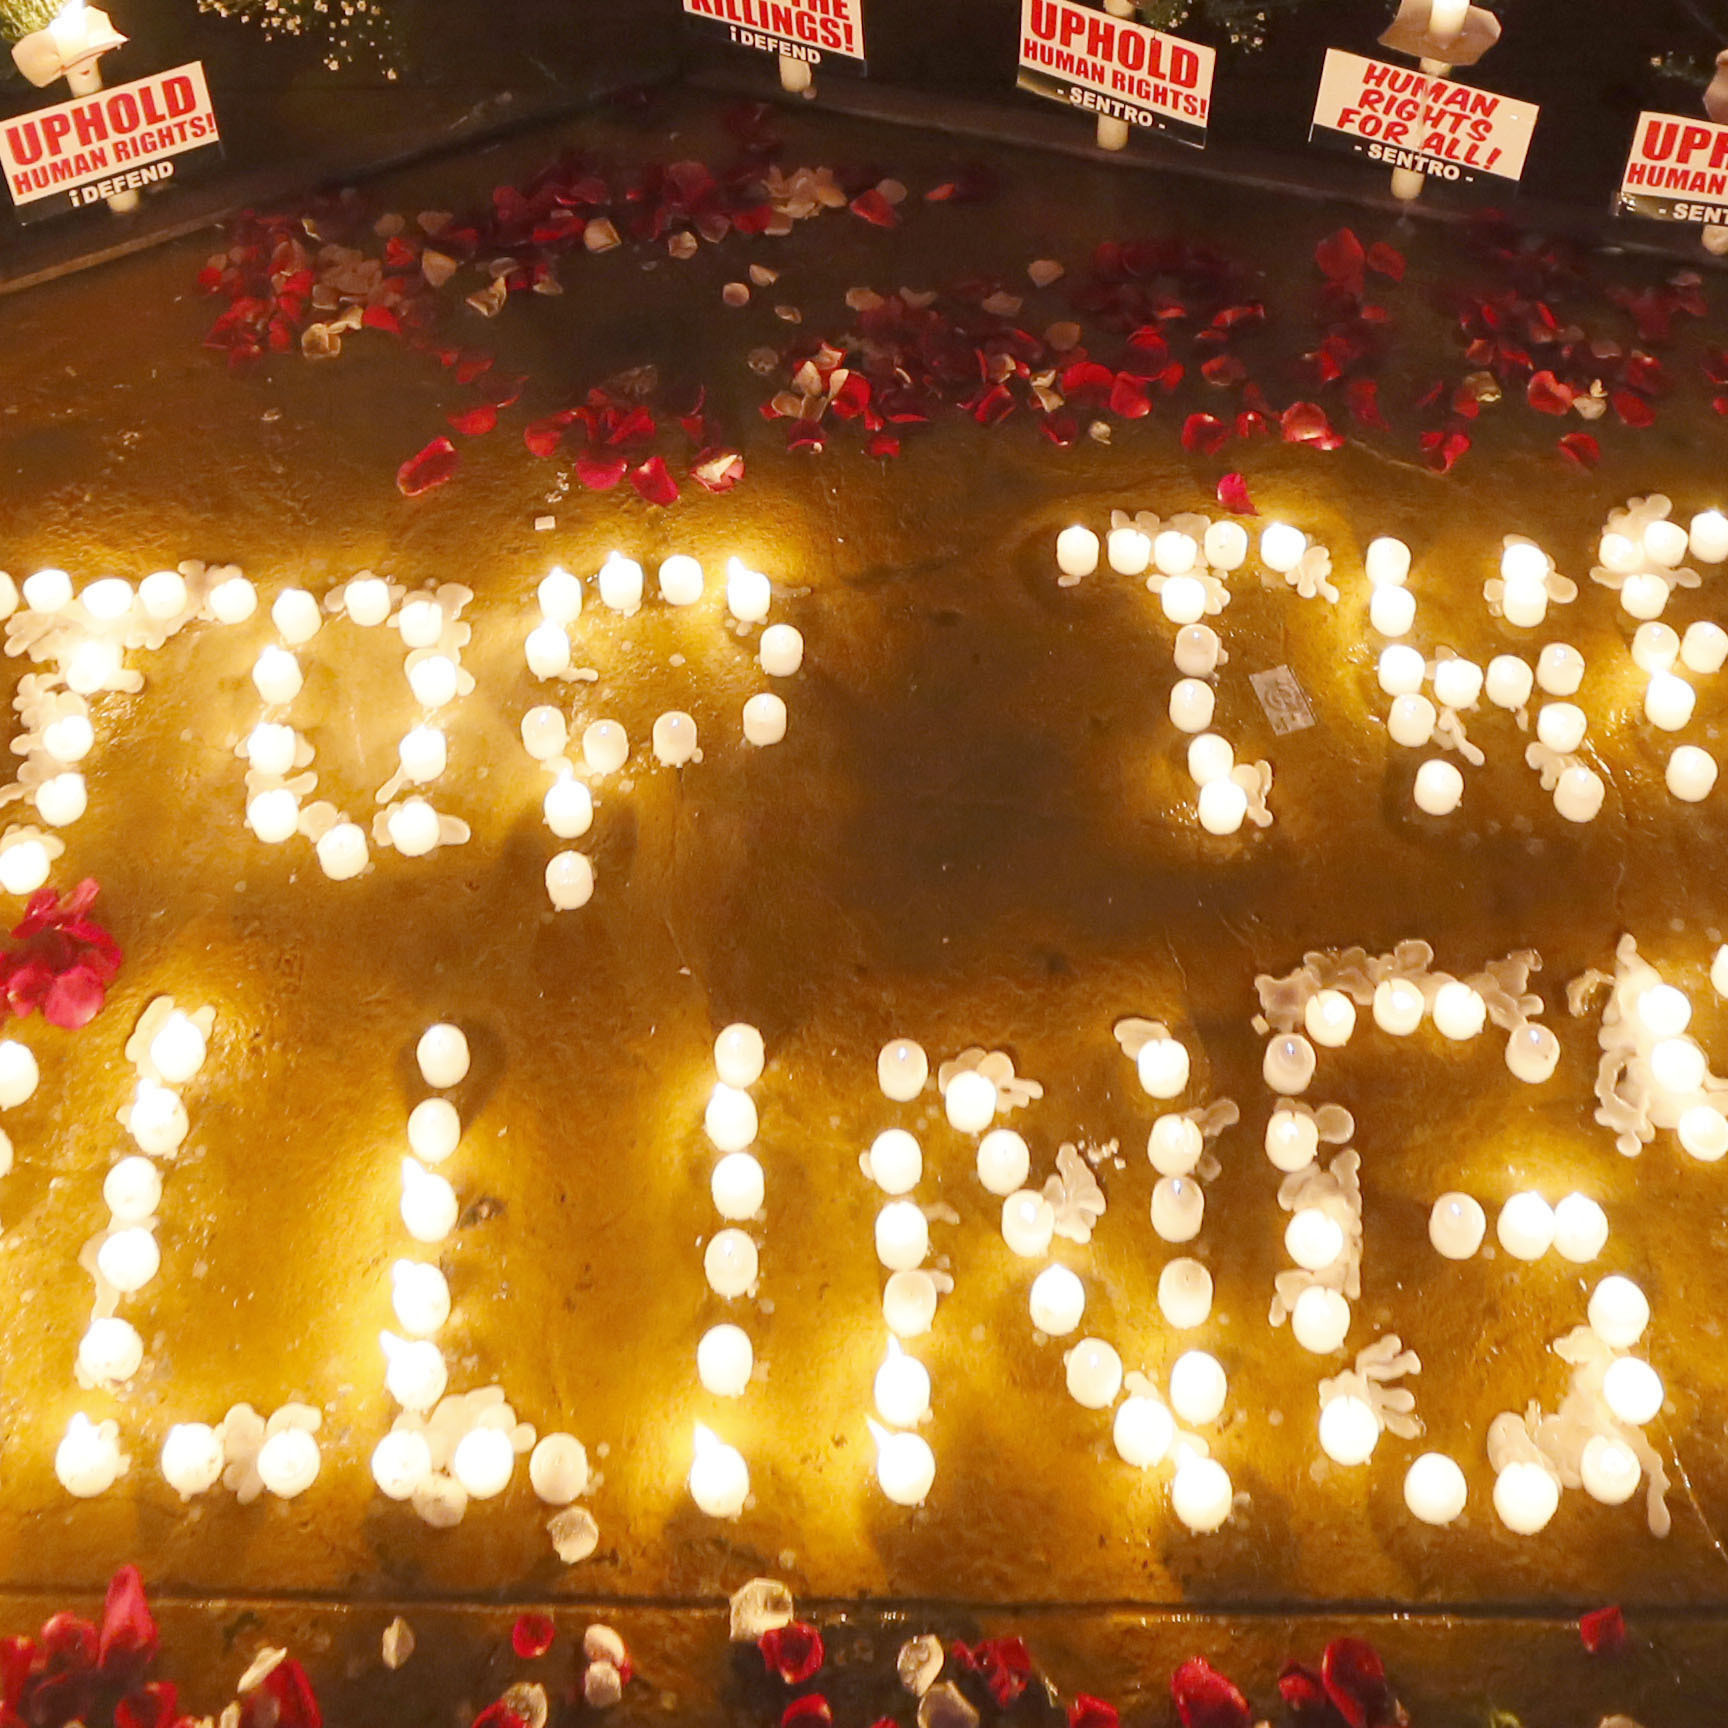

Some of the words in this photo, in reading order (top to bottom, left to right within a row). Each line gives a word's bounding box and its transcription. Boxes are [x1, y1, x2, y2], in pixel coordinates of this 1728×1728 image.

[1023, 37, 1106, 86] HUMAN
[1111, 68, 1209, 119] RIGHTS!
[1361, 62, 1501, 119] HUMAN
[4, 75, 197, 166] UPHOLD
[1069, 86, 1154, 128] SENTRO
[1357, 88, 1494, 142] RIGHTS
[11, 146, 109, 196] HUMAN
[111, 112, 218, 164] RIGHTS!
[1336, 107, 1410, 145] FOR
[1420, 131, 1503, 170] ALL!
[1367, 143, 1460, 181] SENTRO
[1626, 162, 1728, 196] HUMAN
